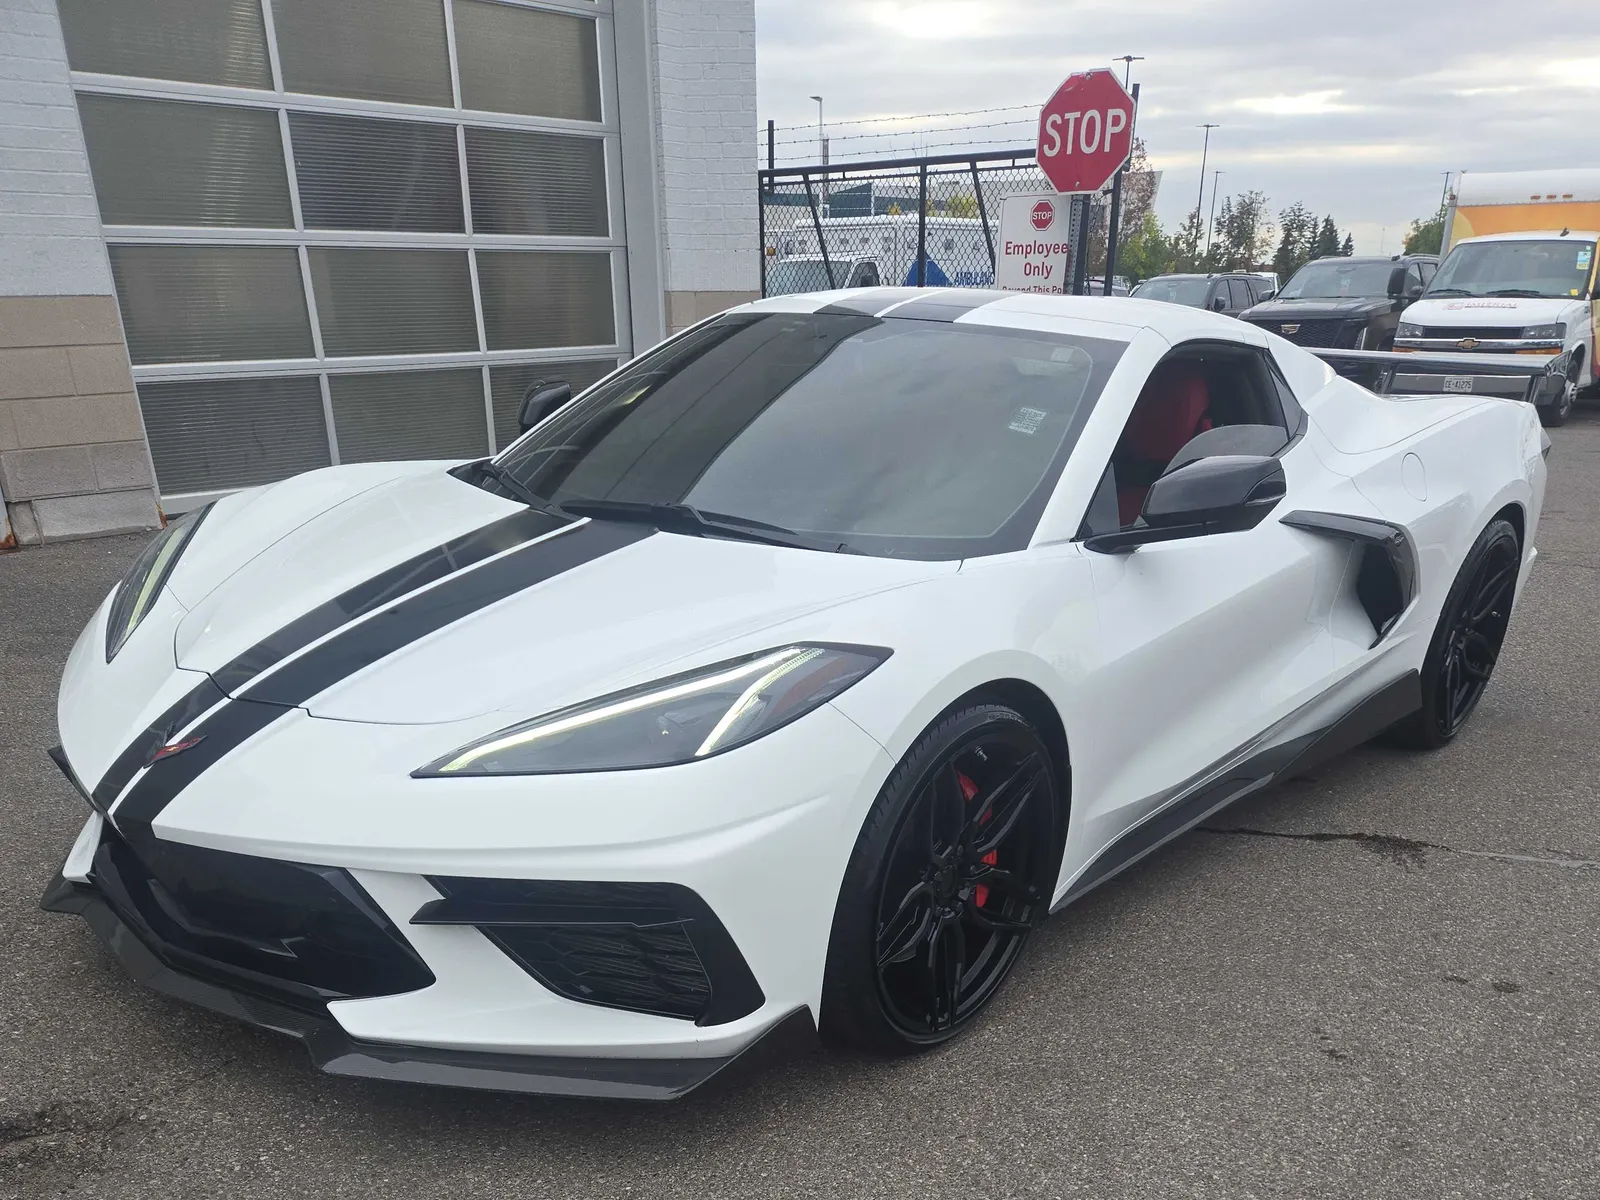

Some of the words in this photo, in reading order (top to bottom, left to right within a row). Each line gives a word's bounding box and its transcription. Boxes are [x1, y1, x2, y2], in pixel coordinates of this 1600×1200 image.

[1043, 108, 1127, 157] STOP
[1032, 211, 1052, 220] STOP
[954, 270, 995, 286] AMBULANC
[1024, 261, 1053, 279] Only
